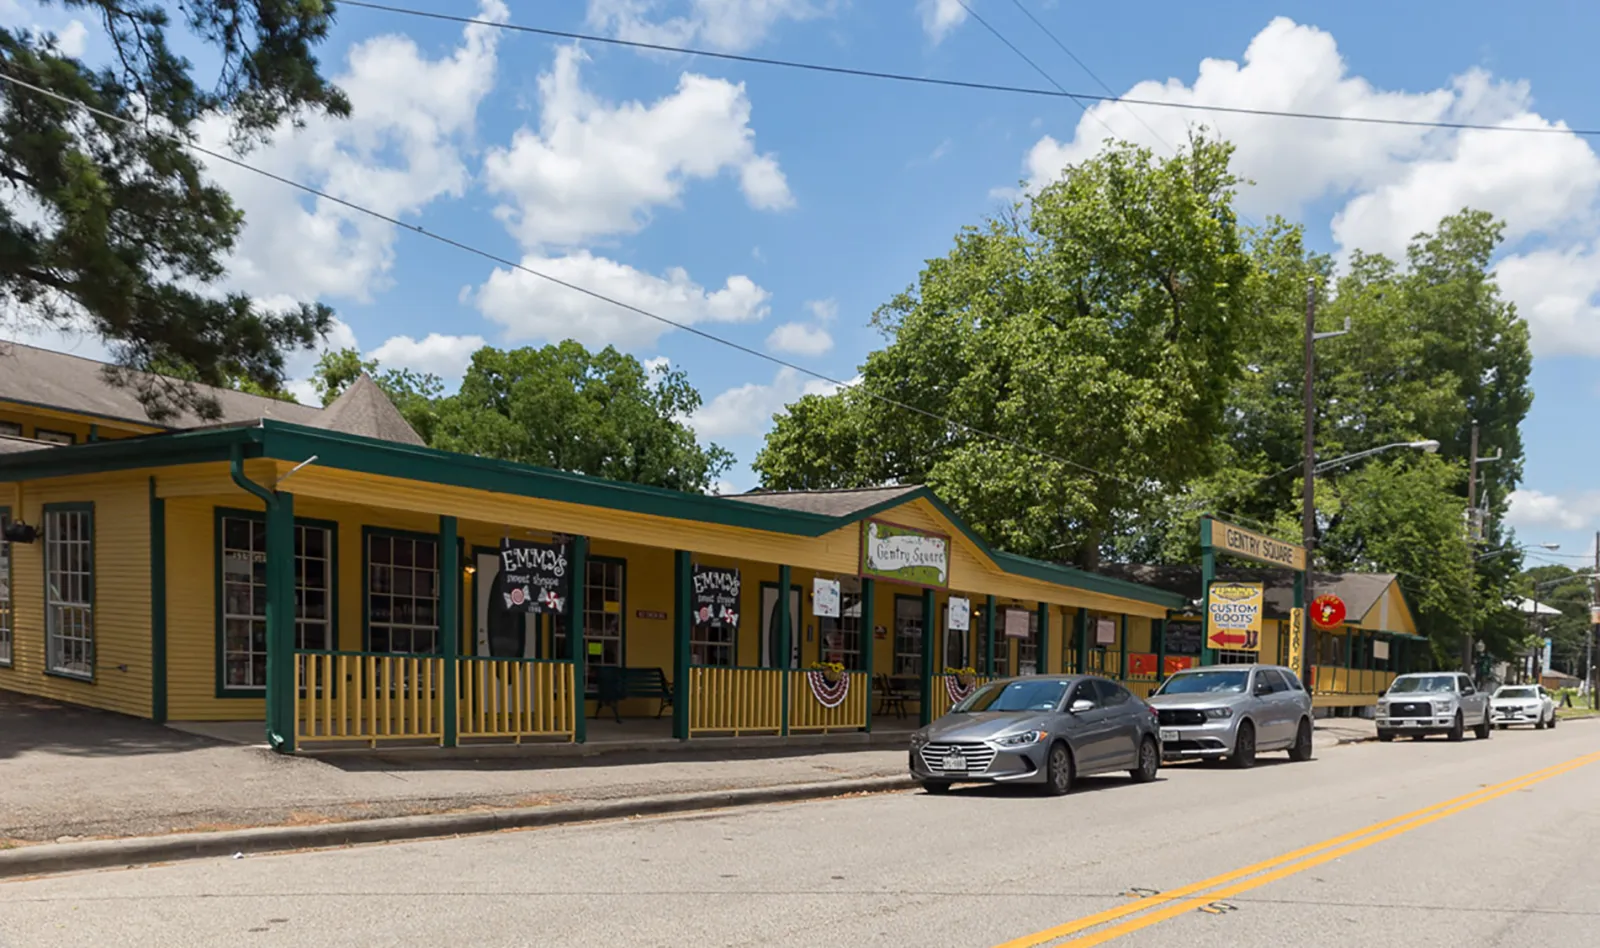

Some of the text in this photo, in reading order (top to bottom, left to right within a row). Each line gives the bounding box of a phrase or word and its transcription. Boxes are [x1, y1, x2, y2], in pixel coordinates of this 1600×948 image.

[877, 543, 944, 565] Gentry Square
[1227, 528, 1293, 564] GENTRY SQUARE
[1209, 603, 1258, 614] CUSTOM
[1213, 612, 1253, 624] BOOTS
